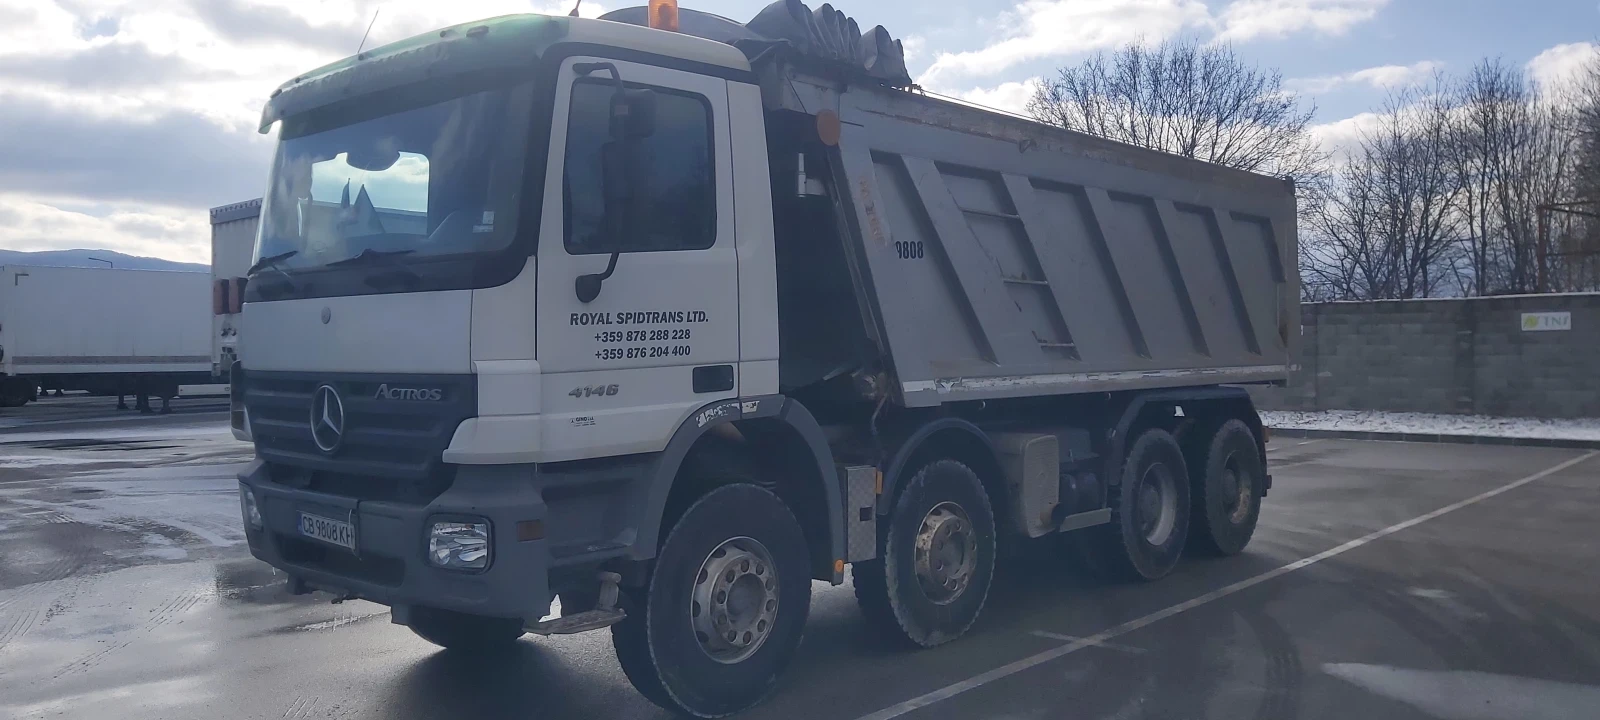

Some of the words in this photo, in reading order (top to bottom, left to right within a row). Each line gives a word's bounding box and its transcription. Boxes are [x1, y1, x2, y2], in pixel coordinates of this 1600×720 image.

[895, 240, 924, 259] 9808
[570, 312, 613, 326] ROYAL
[616, 311, 684, 325] SPIDTRANS
[686, 310, 709, 323] LTD.
[594, 331, 623, 343] +359
[626, 330, 646, 342] 878
[649, 329, 669, 341] 288
[671, 328, 691, 340] 228
[595, 348, 624, 360] +359
[626, 347, 647, 359] 876
[649, 346, 669, 358] 204
[671, 345, 691, 357] 400
[374, 383, 442, 401] ACTROS
[568, 384, 619, 398] 4146
[302, 516, 314, 535] CB
[316, 519, 337, 541] 9808
